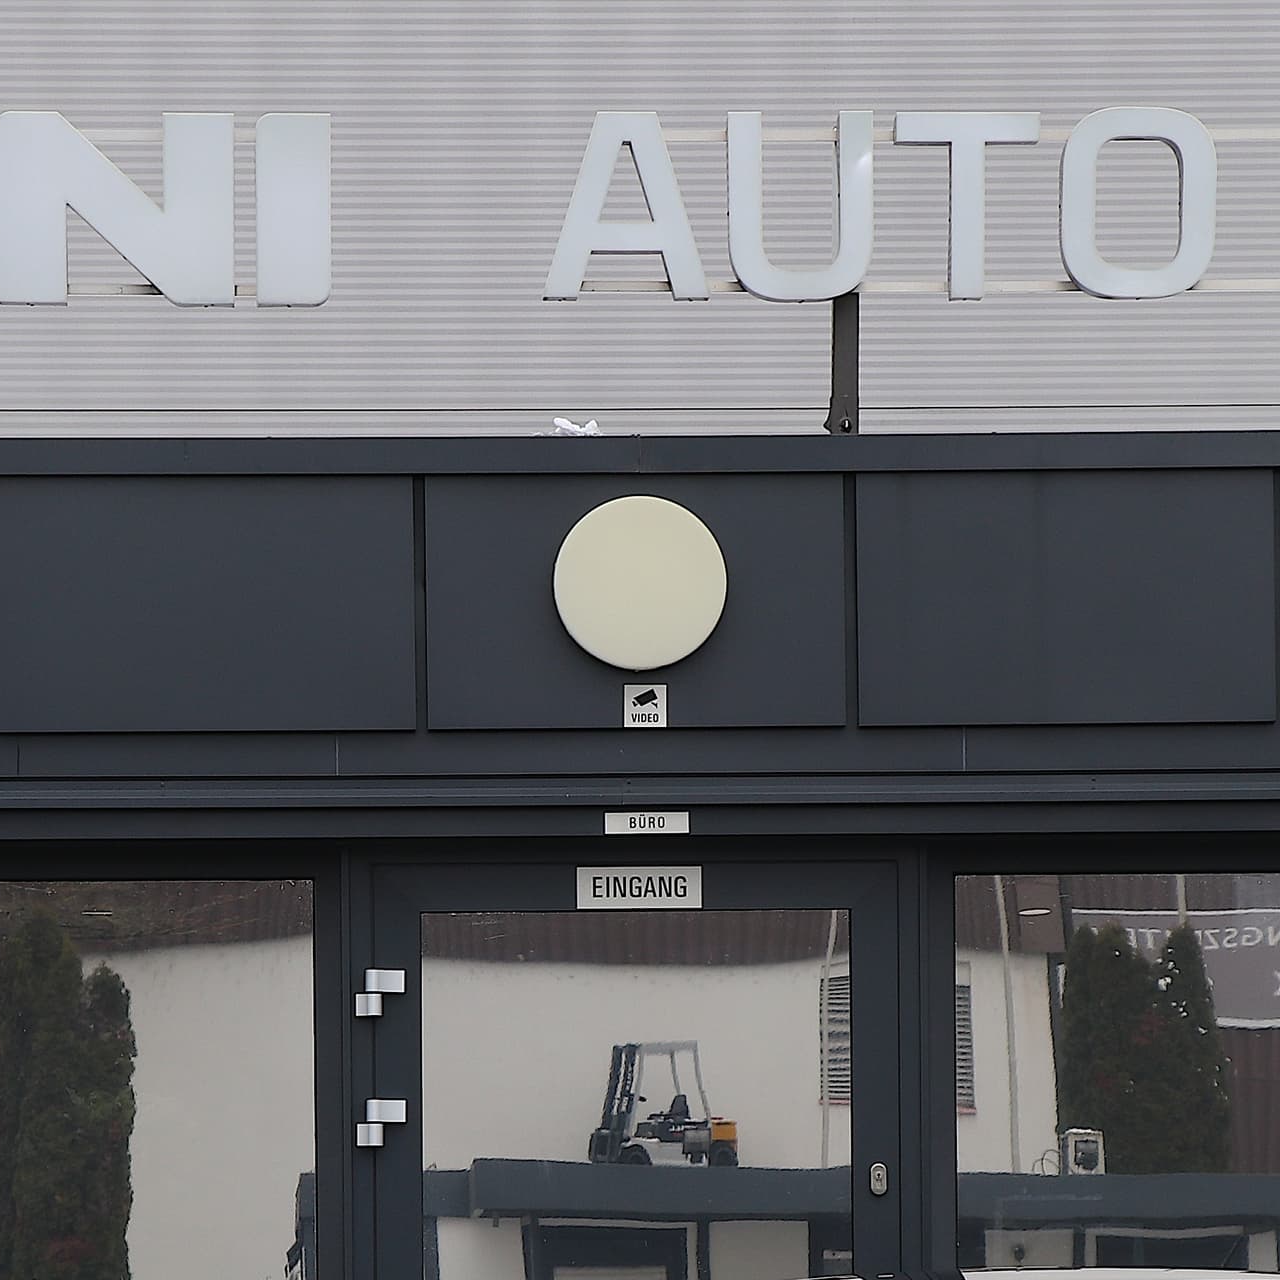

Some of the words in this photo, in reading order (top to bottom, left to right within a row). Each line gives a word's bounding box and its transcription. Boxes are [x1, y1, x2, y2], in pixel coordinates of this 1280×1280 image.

[542, 105, 1218, 303] AUTO
[631, 712, 659, 723] VIDEO
[629, 814, 665, 829] BÜRO
[592, 875, 688, 898] EINGANG
